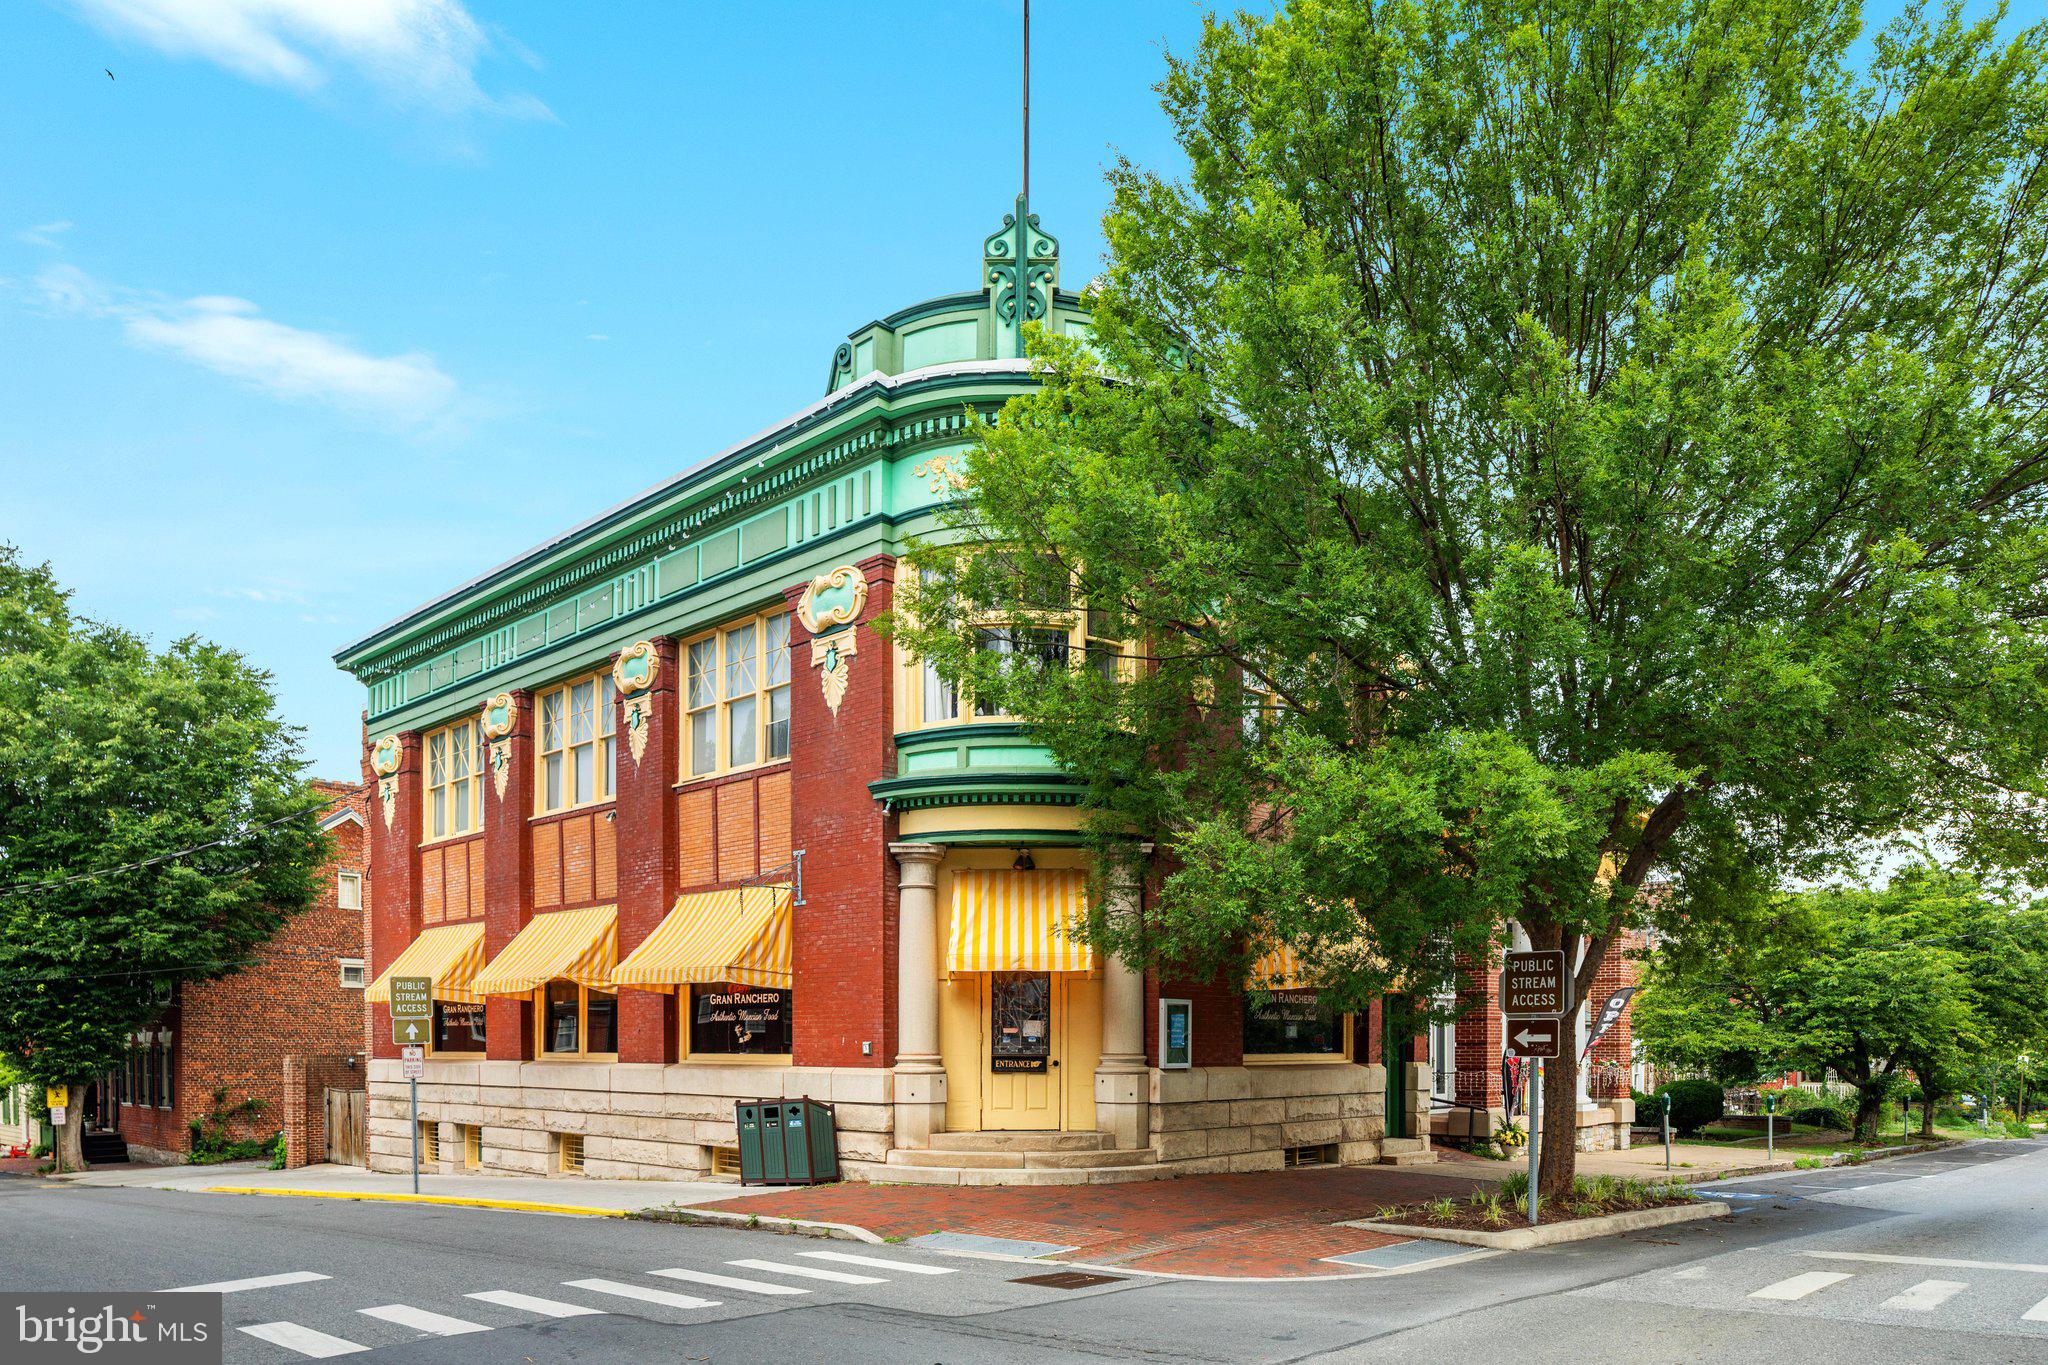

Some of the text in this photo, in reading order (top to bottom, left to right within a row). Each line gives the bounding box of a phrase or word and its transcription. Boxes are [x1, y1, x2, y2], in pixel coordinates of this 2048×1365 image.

[1513, 959, 1554, 972] PUBLIC
[396, 982, 426, 990] PUBLIC
[1512, 976, 1556, 989] STREAM
[395, 993, 427, 1001] STREAM
[709, 993, 780, 1005] GRAN RANCHERO
[1278, 992, 1318, 1004] RANCHERO
[1511, 994, 1556, 1007] ACCESS
[396, 1004, 427, 1012] ACCESS
[443, 1004, 484, 1013] GRAN RANCHERO
[710, 1010, 737, 1022] Authentic
[763, 1008, 780, 1021] Food
[995, 1060, 1031, 1068] ENTRANCE
